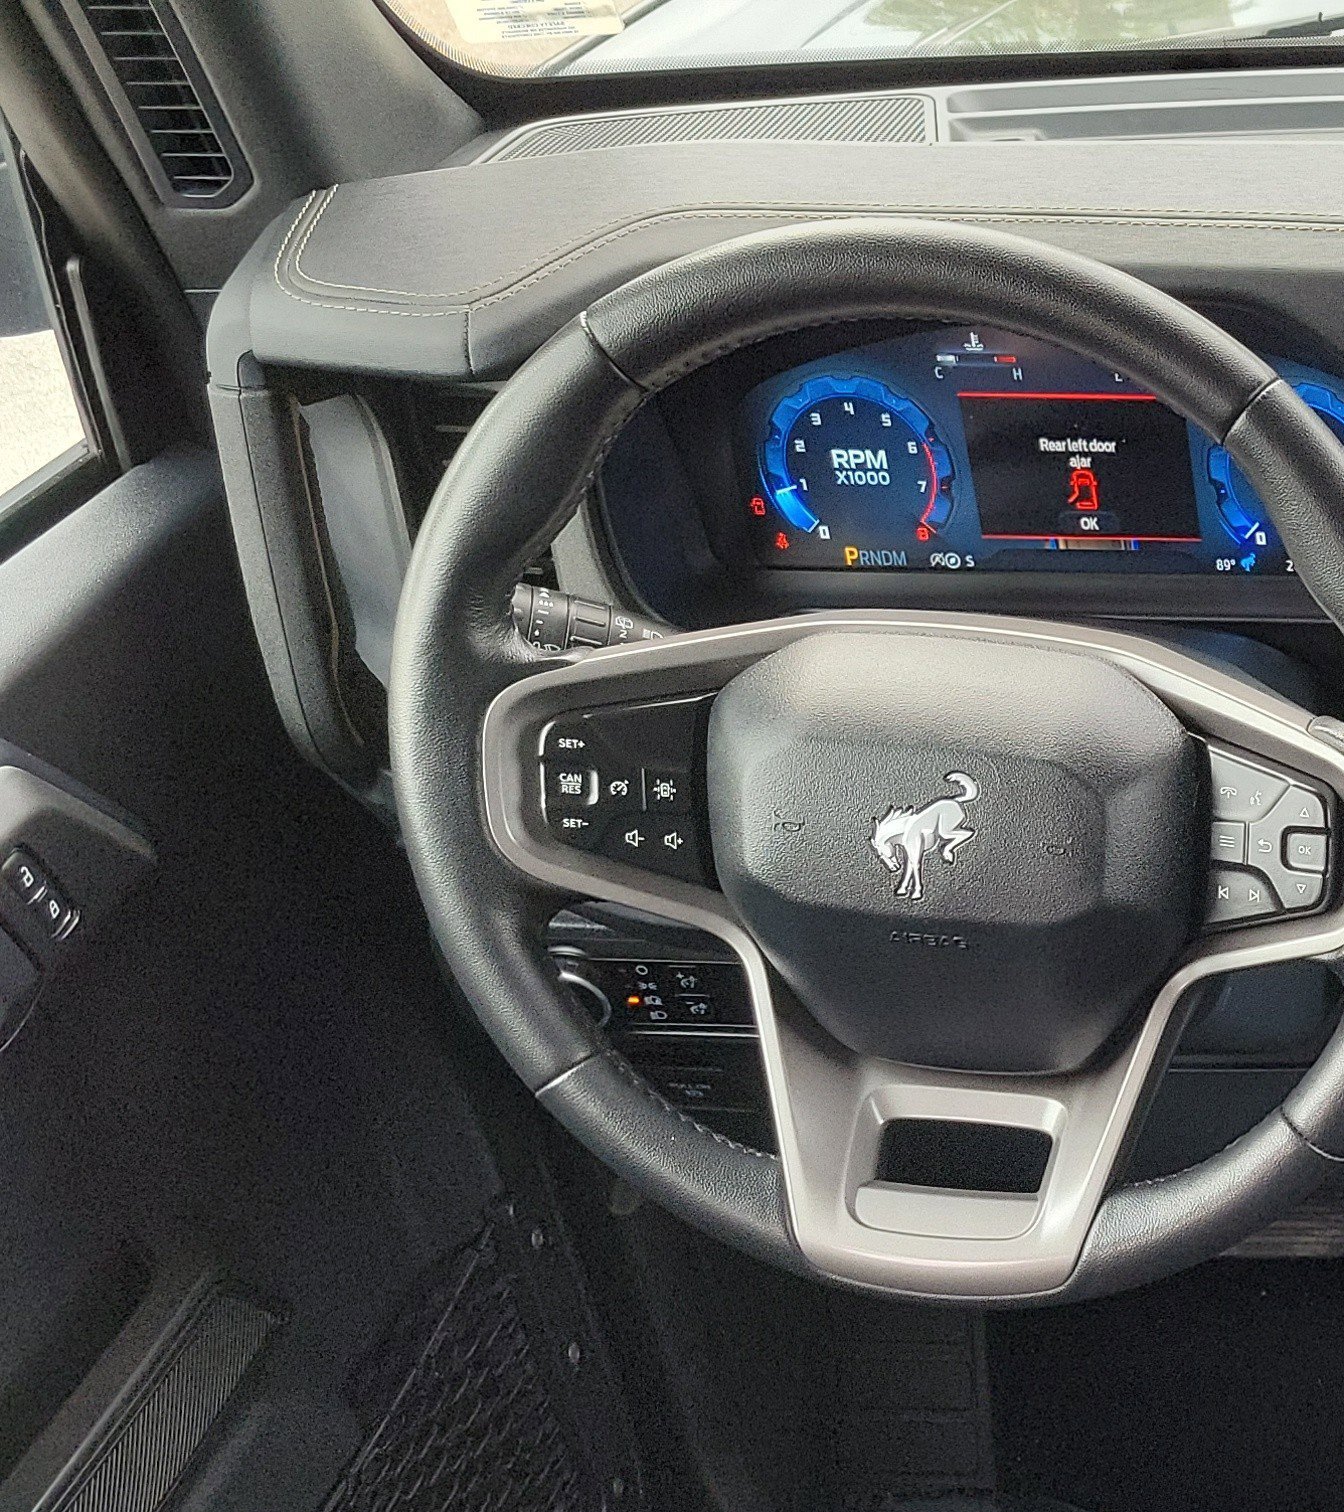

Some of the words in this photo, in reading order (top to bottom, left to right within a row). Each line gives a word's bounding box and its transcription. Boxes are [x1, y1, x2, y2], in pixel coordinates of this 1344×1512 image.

[934, 366, 944, 379] C
[1013, 368, 1023, 381] H
[844, 402, 855, 415] 4
[811, 413, 822, 425] 3
[881, 413, 892, 427] 5
[794, 439, 806, 453] 2
[907, 441, 918, 455] 6
[1038, 437, 1066, 452] Rear
[1067, 438, 1088, 452] left
[1088, 438, 1117, 453] door
[831, 449, 889, 469] RPM
[1069, 455, 1092, 469] ajar
[800, 479, 809, 491] 1
[917, 480, 928, 493] 7
[1080, 516, 1100, 531] OK
[818, 525, 831, 540] 0
[965, 555, 975, 568] S
[558, 737, 586, 749] SET+
[559, 773, 583, 783] CAN
[561, 784, 582, 795] RES
[1298, 845, 1312, 856] OK
